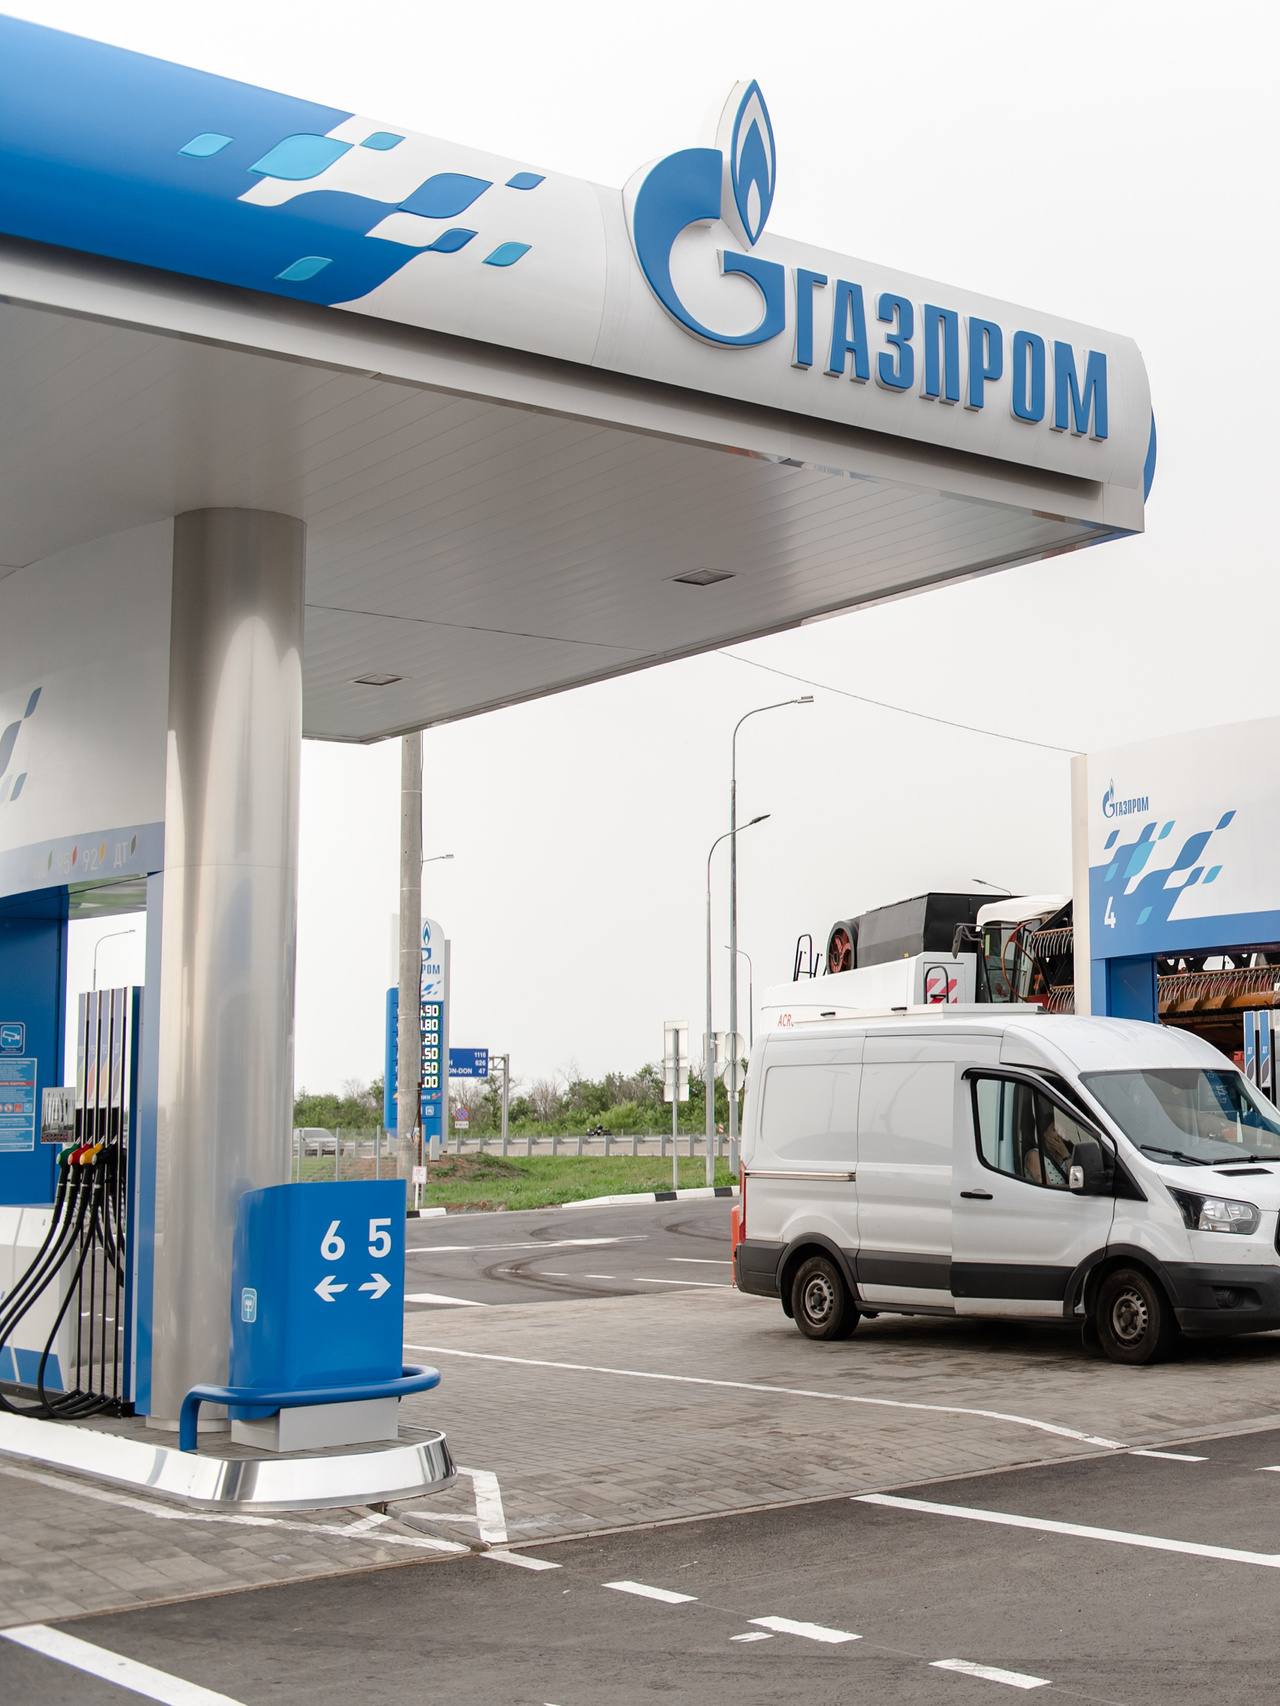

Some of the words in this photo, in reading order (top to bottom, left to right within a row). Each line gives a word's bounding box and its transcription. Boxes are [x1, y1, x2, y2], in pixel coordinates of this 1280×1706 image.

[795, 268, 1108, 440] ГАЗПРОМ
[1115, 796, 1149, 817] ГАЗПРОМ
[57, 852, 70, 875] 95
[82, 848, 98, 872] 92
[113, 842, 128, 869] ДТ
[1103, 896, 1116, 929] 4
[422, 964, 440, 975] РОМ
[422, 1033, 439, 1045] .20
[422, 1047, 439, 1060] .50
[422, 1062, 439, 1074] .50
[422, 1076, 439, 1088] .00
[320, 1219, 346, 1261] 6
[367, 1217, 392, 1258] 5
